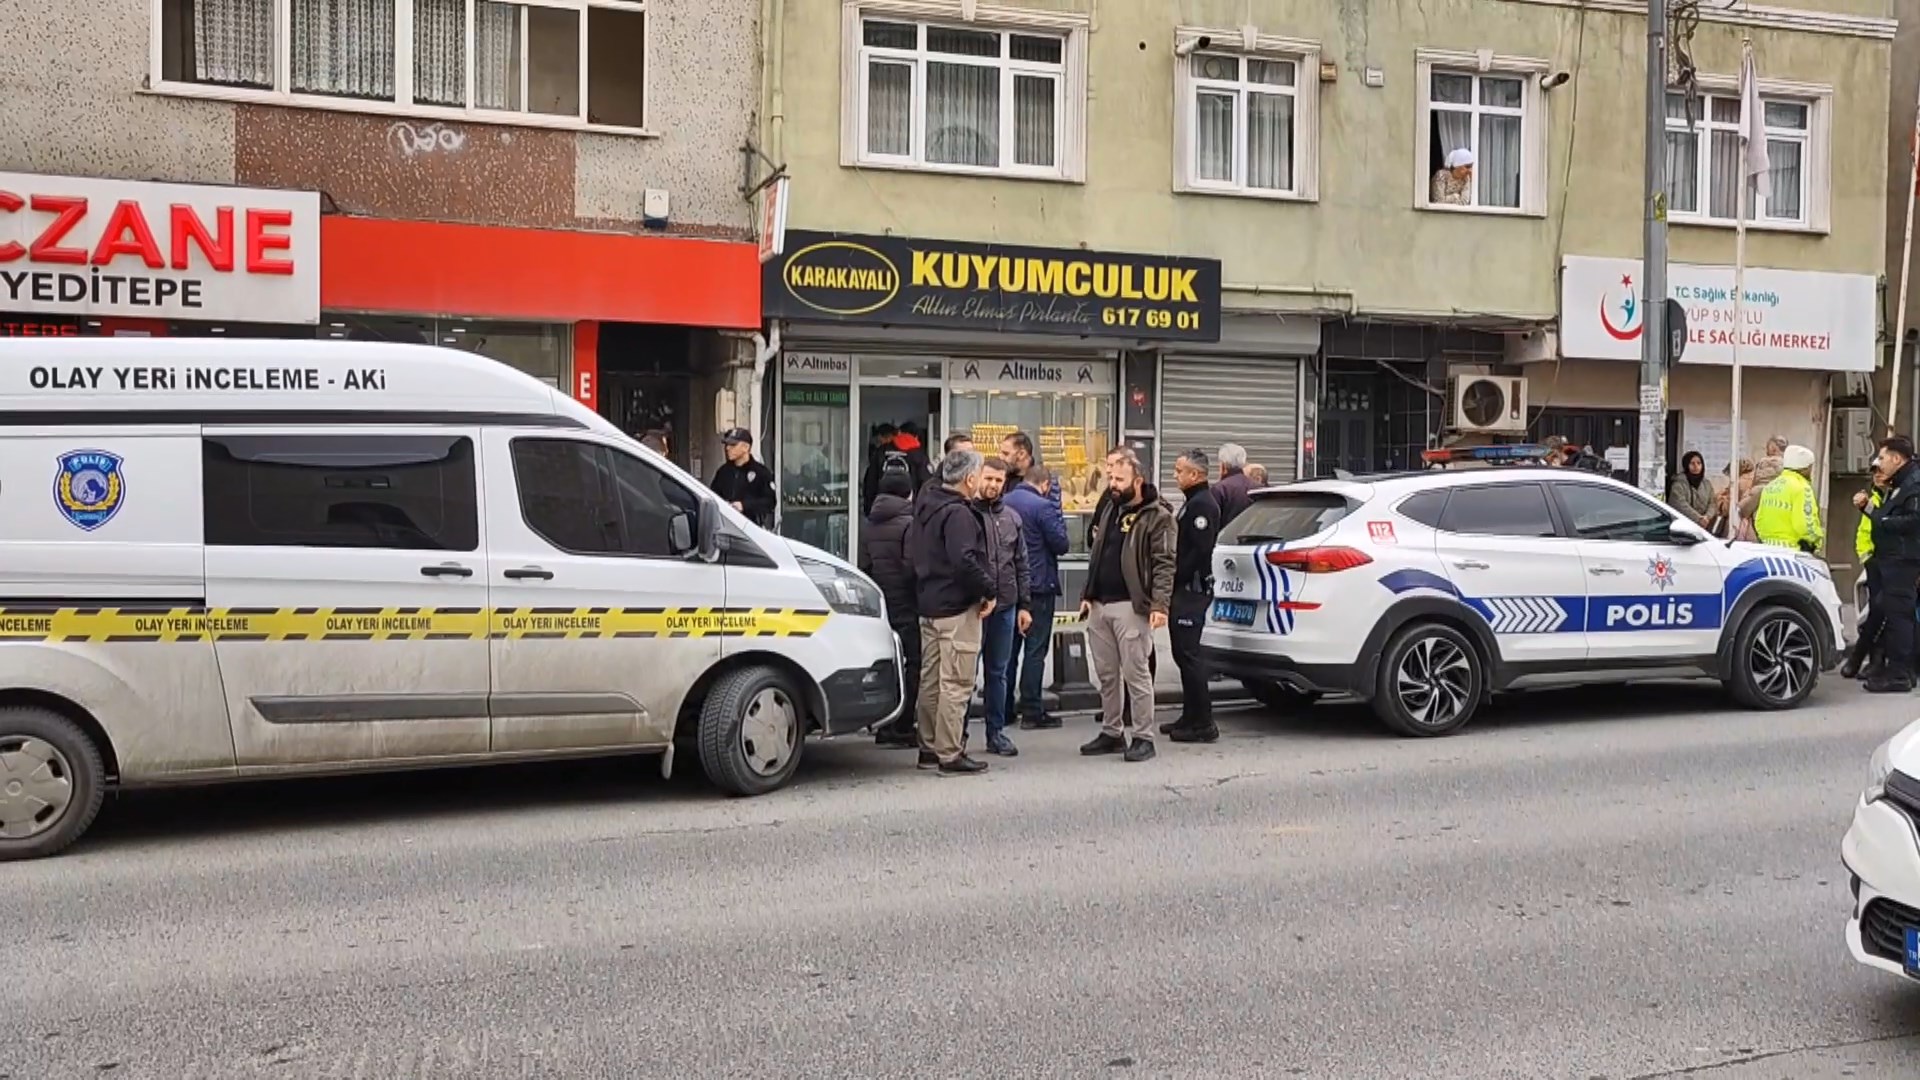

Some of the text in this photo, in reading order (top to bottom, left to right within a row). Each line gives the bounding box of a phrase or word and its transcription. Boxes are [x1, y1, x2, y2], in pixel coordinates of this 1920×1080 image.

[791, 265, 891, 291] KARAKAYALI
[912, 251, 1199, 302] KUYUMCULUK
[0, 267, 202, 308] YEDİTEPE
[1693, 287, 1727, 303] Sağlık
[1730, 287, 1780, 307] Bkanlığı
[962, 297, 1017, 320] Elmas
[1102, 307, 1199, 329] 617 69 01
[1712, 309, 1720, 323] 9
[1770, 332, 1831, 350] MERKEZİ
[29, 366, 103, 390] OLAY
[580, 371, 591, 399] E
[1370, 522, 1393, 537] 112
[1606, 597, 1693, 626] POLİS
[135, 618, 163, 632] OLAY
[326, 617, 352, 630] OLAY
[503, 616, 528, 629] OLAY
[666, 616, 689, 629] OLAY
